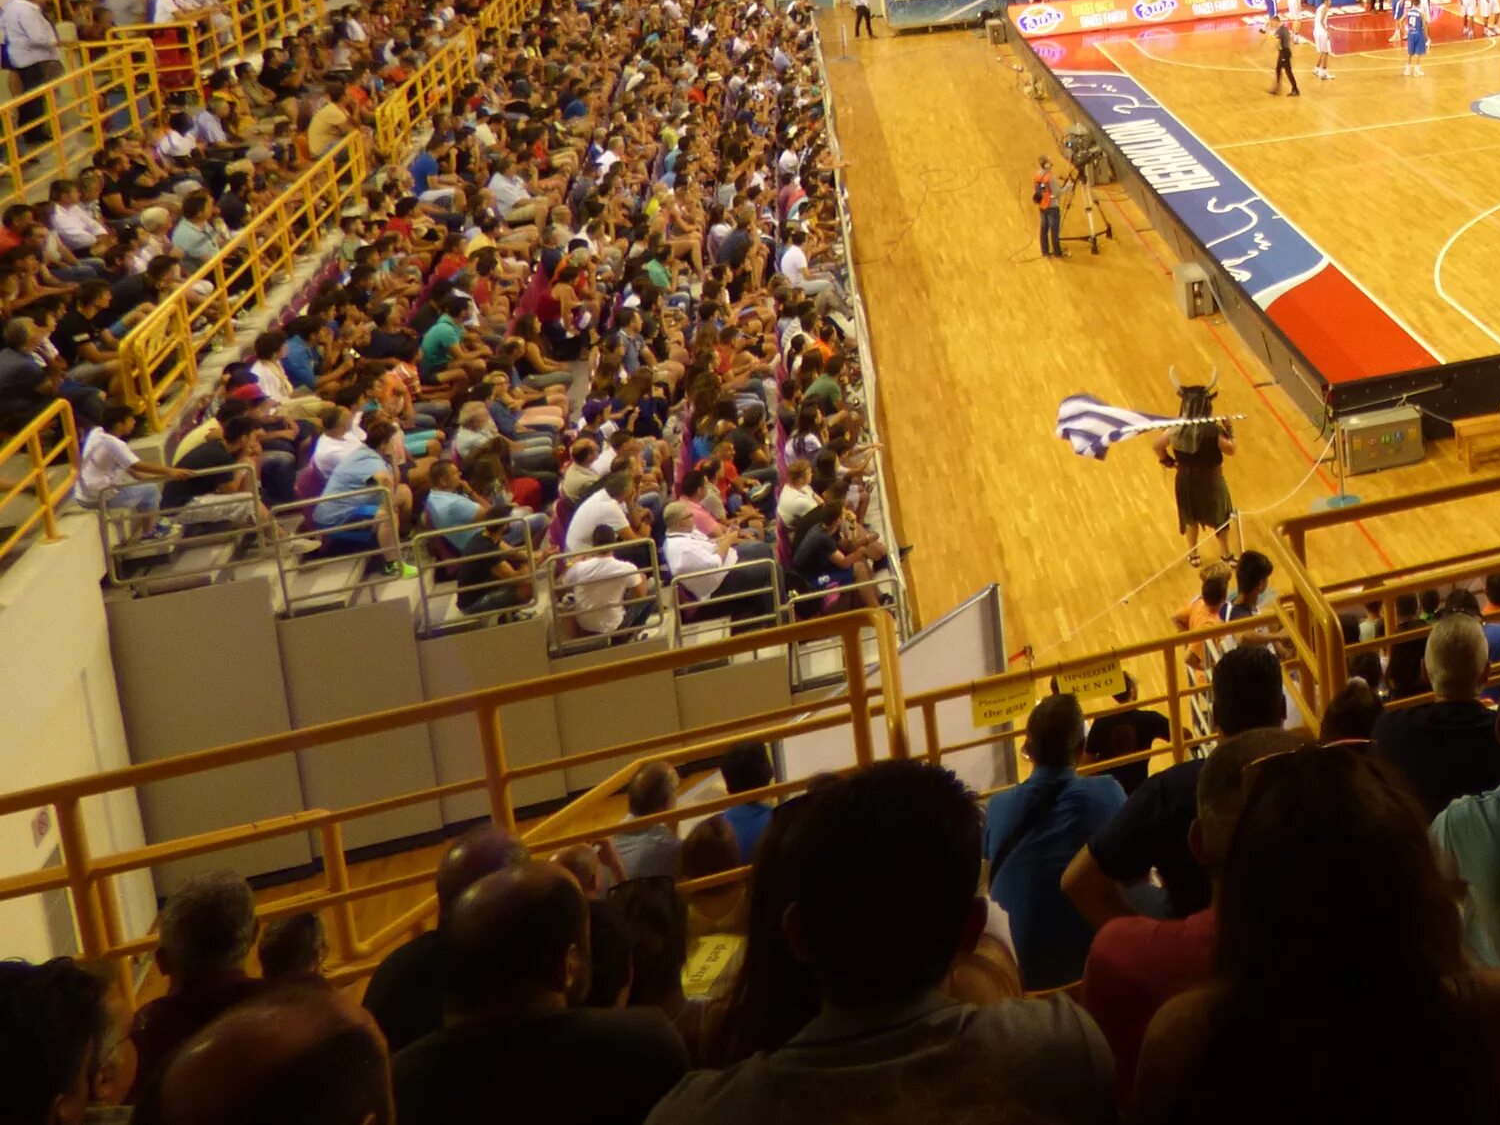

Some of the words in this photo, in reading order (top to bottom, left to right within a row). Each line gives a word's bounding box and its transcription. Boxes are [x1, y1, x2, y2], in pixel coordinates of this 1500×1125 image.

[1019, 11, 1062, 32] Fanta
[1101, 118, 1220, 194] HERAKLION
[983, 706, 1003, 719] the
[1006, 701, 1028, 716] gap
